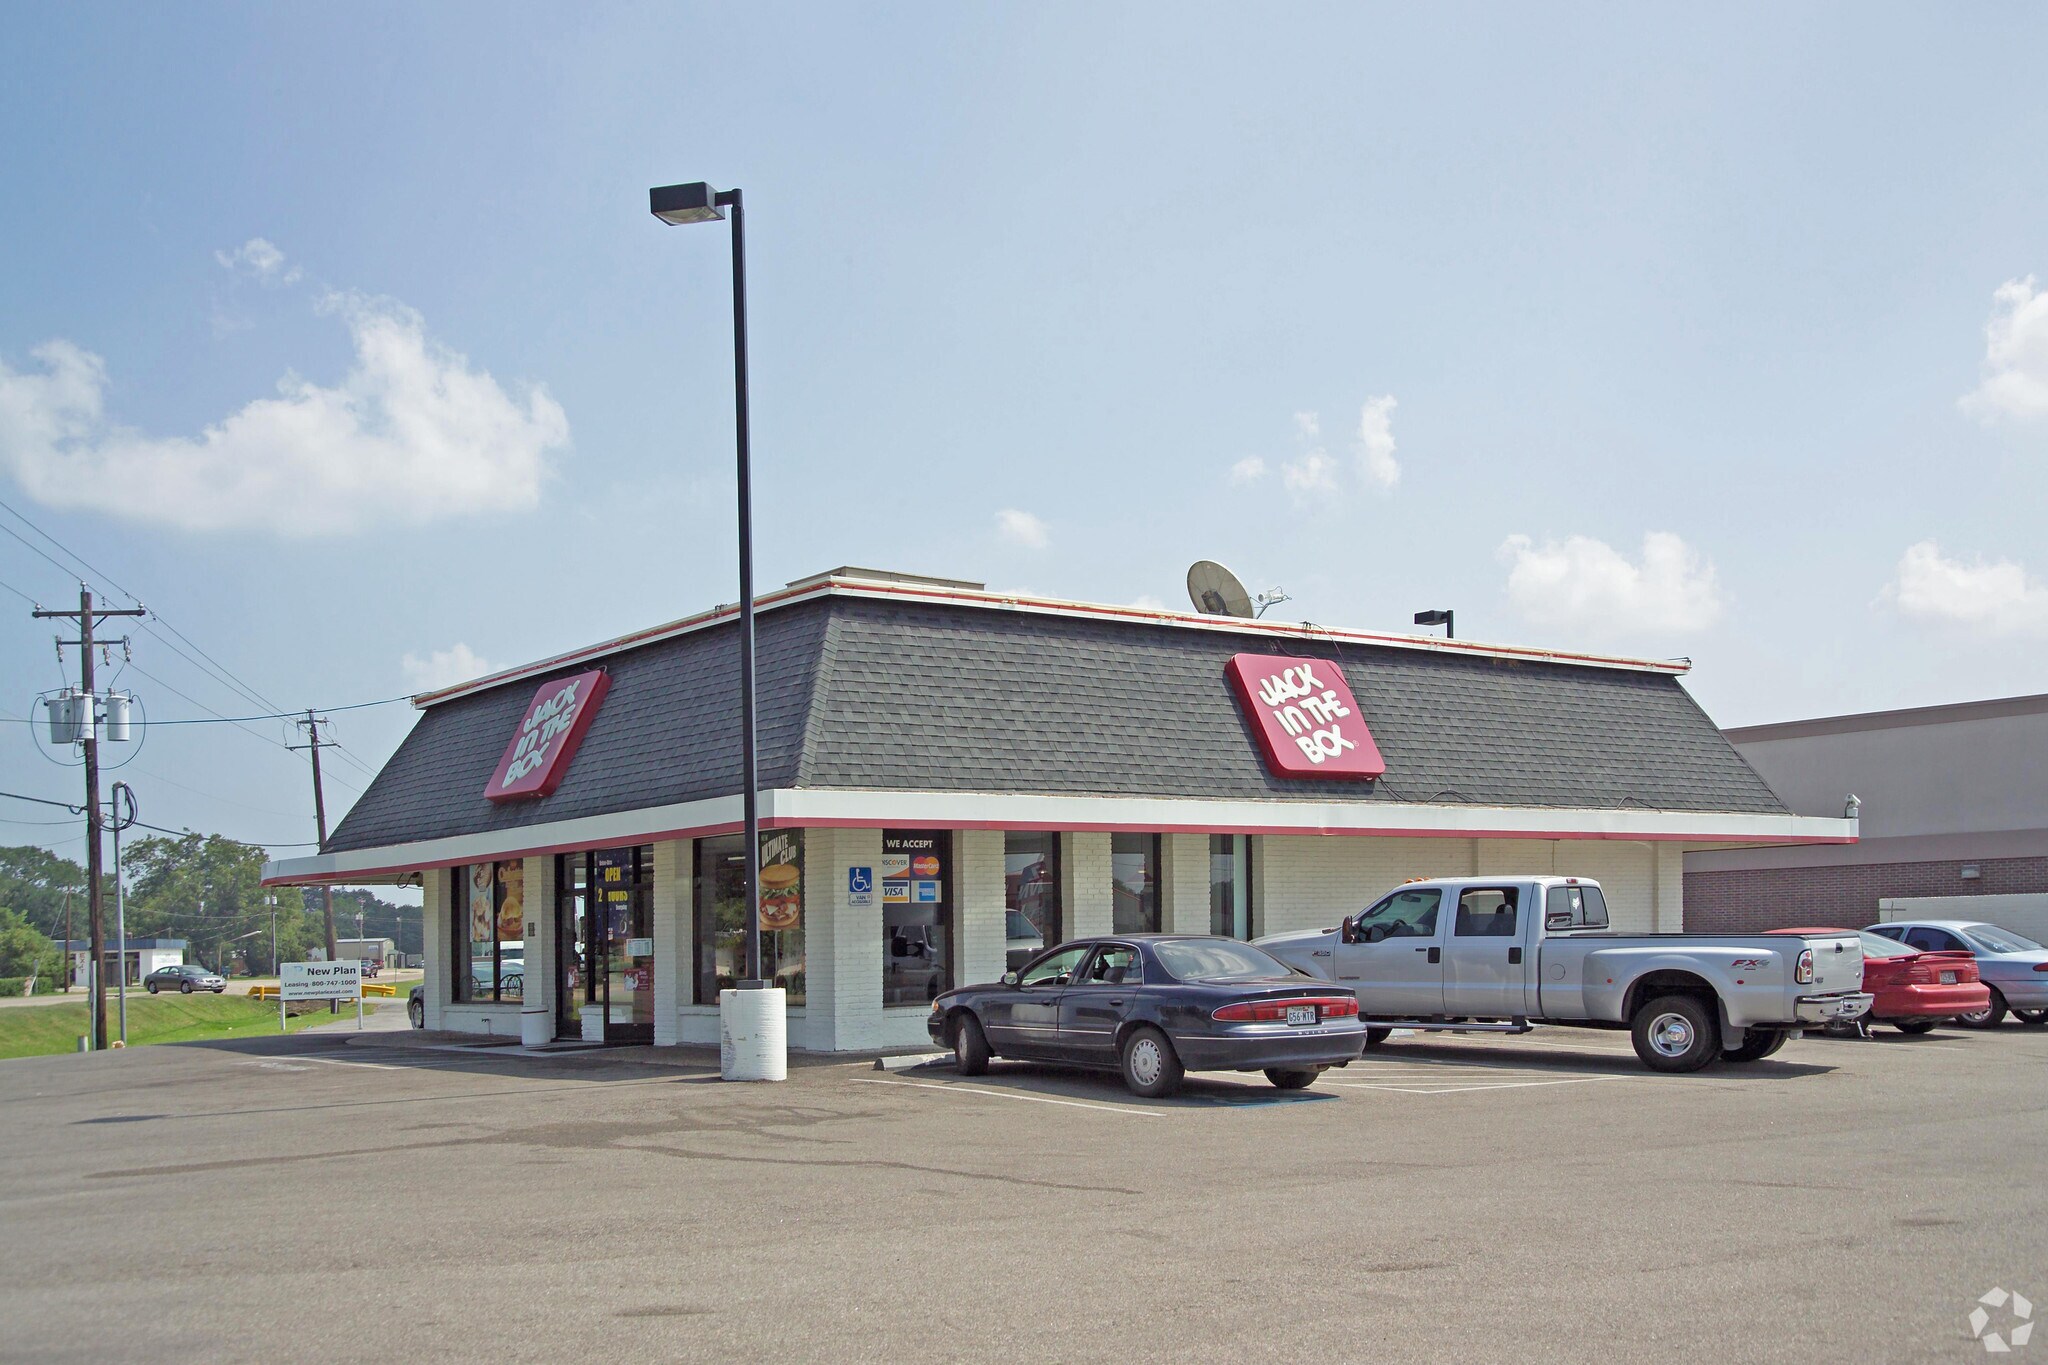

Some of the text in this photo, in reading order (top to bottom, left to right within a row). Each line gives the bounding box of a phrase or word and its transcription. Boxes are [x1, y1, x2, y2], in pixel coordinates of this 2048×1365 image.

[1257, 663, 1325, 707] JACK
[523, 679, 581, 733] JACK
[1272, 690, 1350, 737] IN THE
[512, 703, 577, 762] IN THE
[1295, 724, 1355, 764] BOX
[502, 742, 550, 789] BOX
[761, 834, 789, 868] ULTIMATE
[780, 845, 797, 865] CLUB
[886, 839, 934, 848] WE ACCEPT
[605, 867, 621, 882] OPEN
[884, 887, 904, 896] VISA
[307, 967, 331, 976] New
[333, 966, 356, 976] Plan
[311, 979, 357, 987] 800-747-1000
